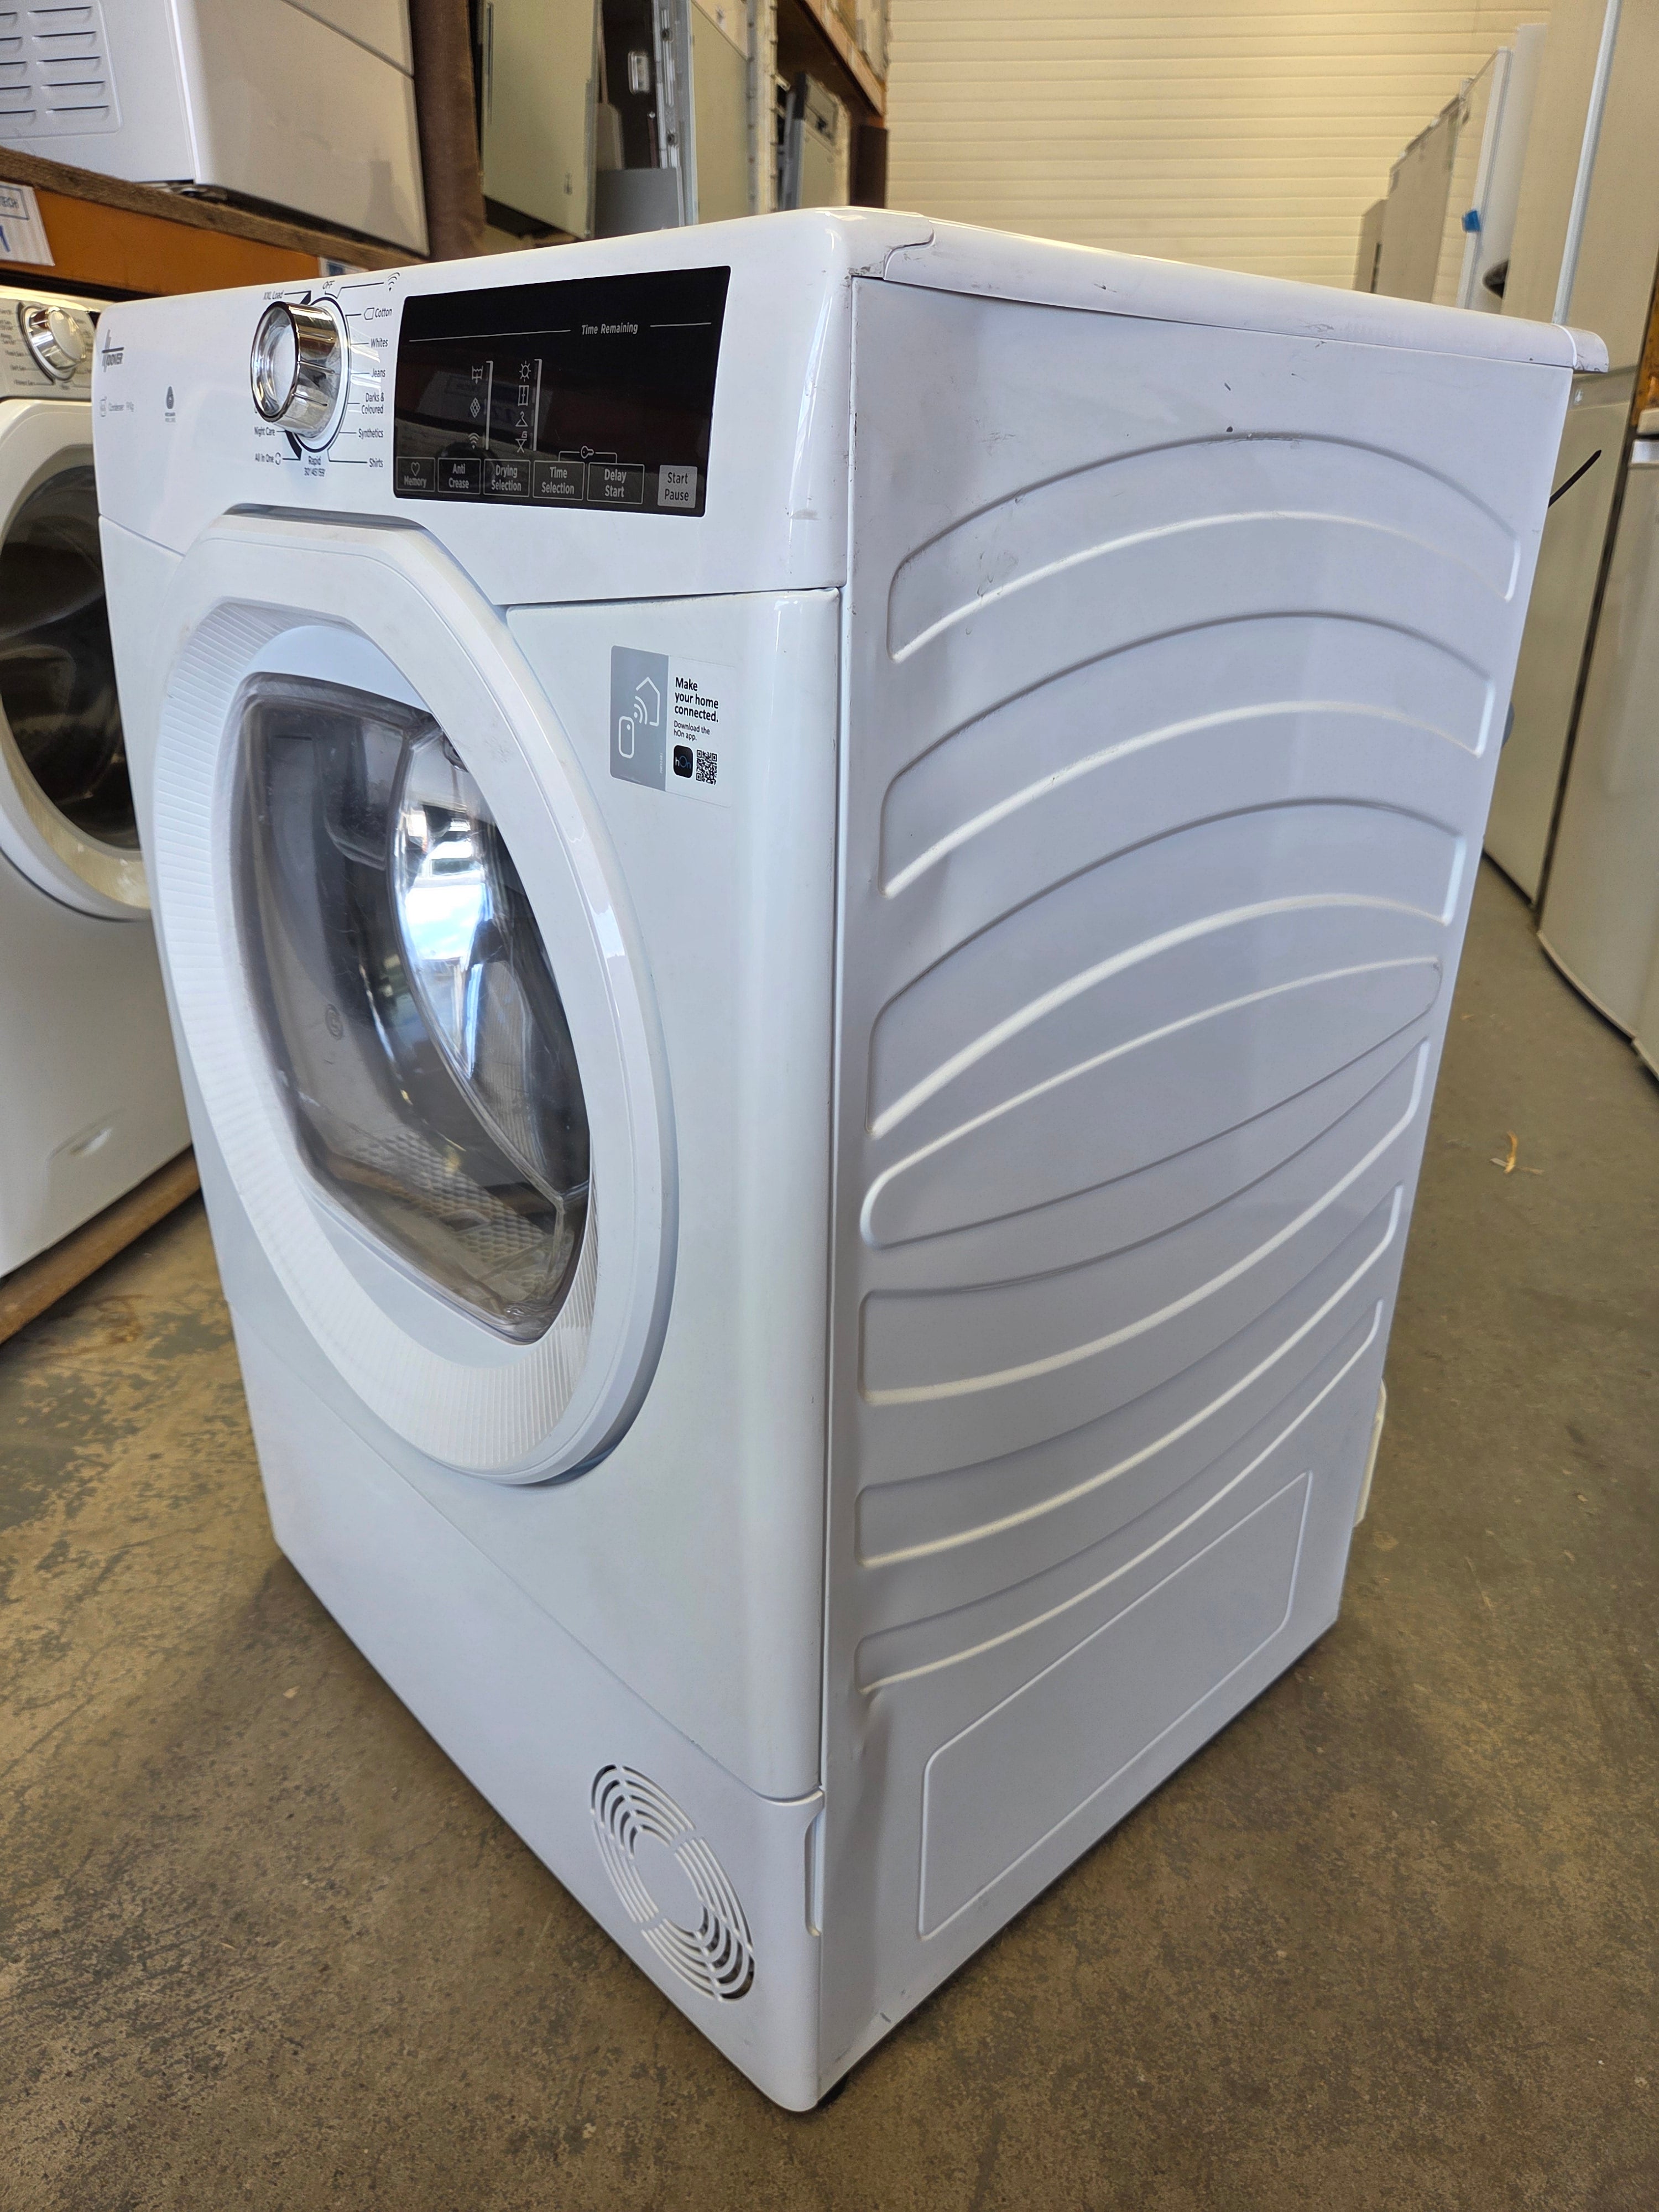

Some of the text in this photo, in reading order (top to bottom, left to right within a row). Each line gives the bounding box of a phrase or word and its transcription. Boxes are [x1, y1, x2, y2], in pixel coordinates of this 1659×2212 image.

[272, 290, 284, 299] Load
[374, 308, 393, 318] Cotton
[582, 322, 638, 335] Time Remaining
[371, 338, 388, 348] Whites
[371, 368, 386, 378] Jeans
[366, 392, 384, 402] Darks &
[361, 405, 384, 414] Coloured
[254, 426, 275, 437] Night Care
[358, 428, 384, 440] Synthetics
[308, 456, 321, 466] Rapid
[369, 458, 384, 468] Shirts
[452, 463, 466, 474] Anti
[495, 465, 518, 478] Drying
[550, 466, 567, 479] Time
[404, 476, 427, 488] Memory
[604, 468, 627, 484] Delay
[667, 472, 688, 484] Start
[448, 477, 469, 489] Crease
[491, 479, 521, 492] Selection
[541, 482, 575, 495] Selection
[605, 484, 624, 498] Start
[664, 489, 690, 501] Pause
[675, 677, 698, 691] Make
[675, 692, 719, 709] your home
[674, 706, 719, 723] connected.
[674, 720, 710, 735] Download the
[674, 729, 697, 742] hOn app.
[675, 756, 691, 769] hOn
